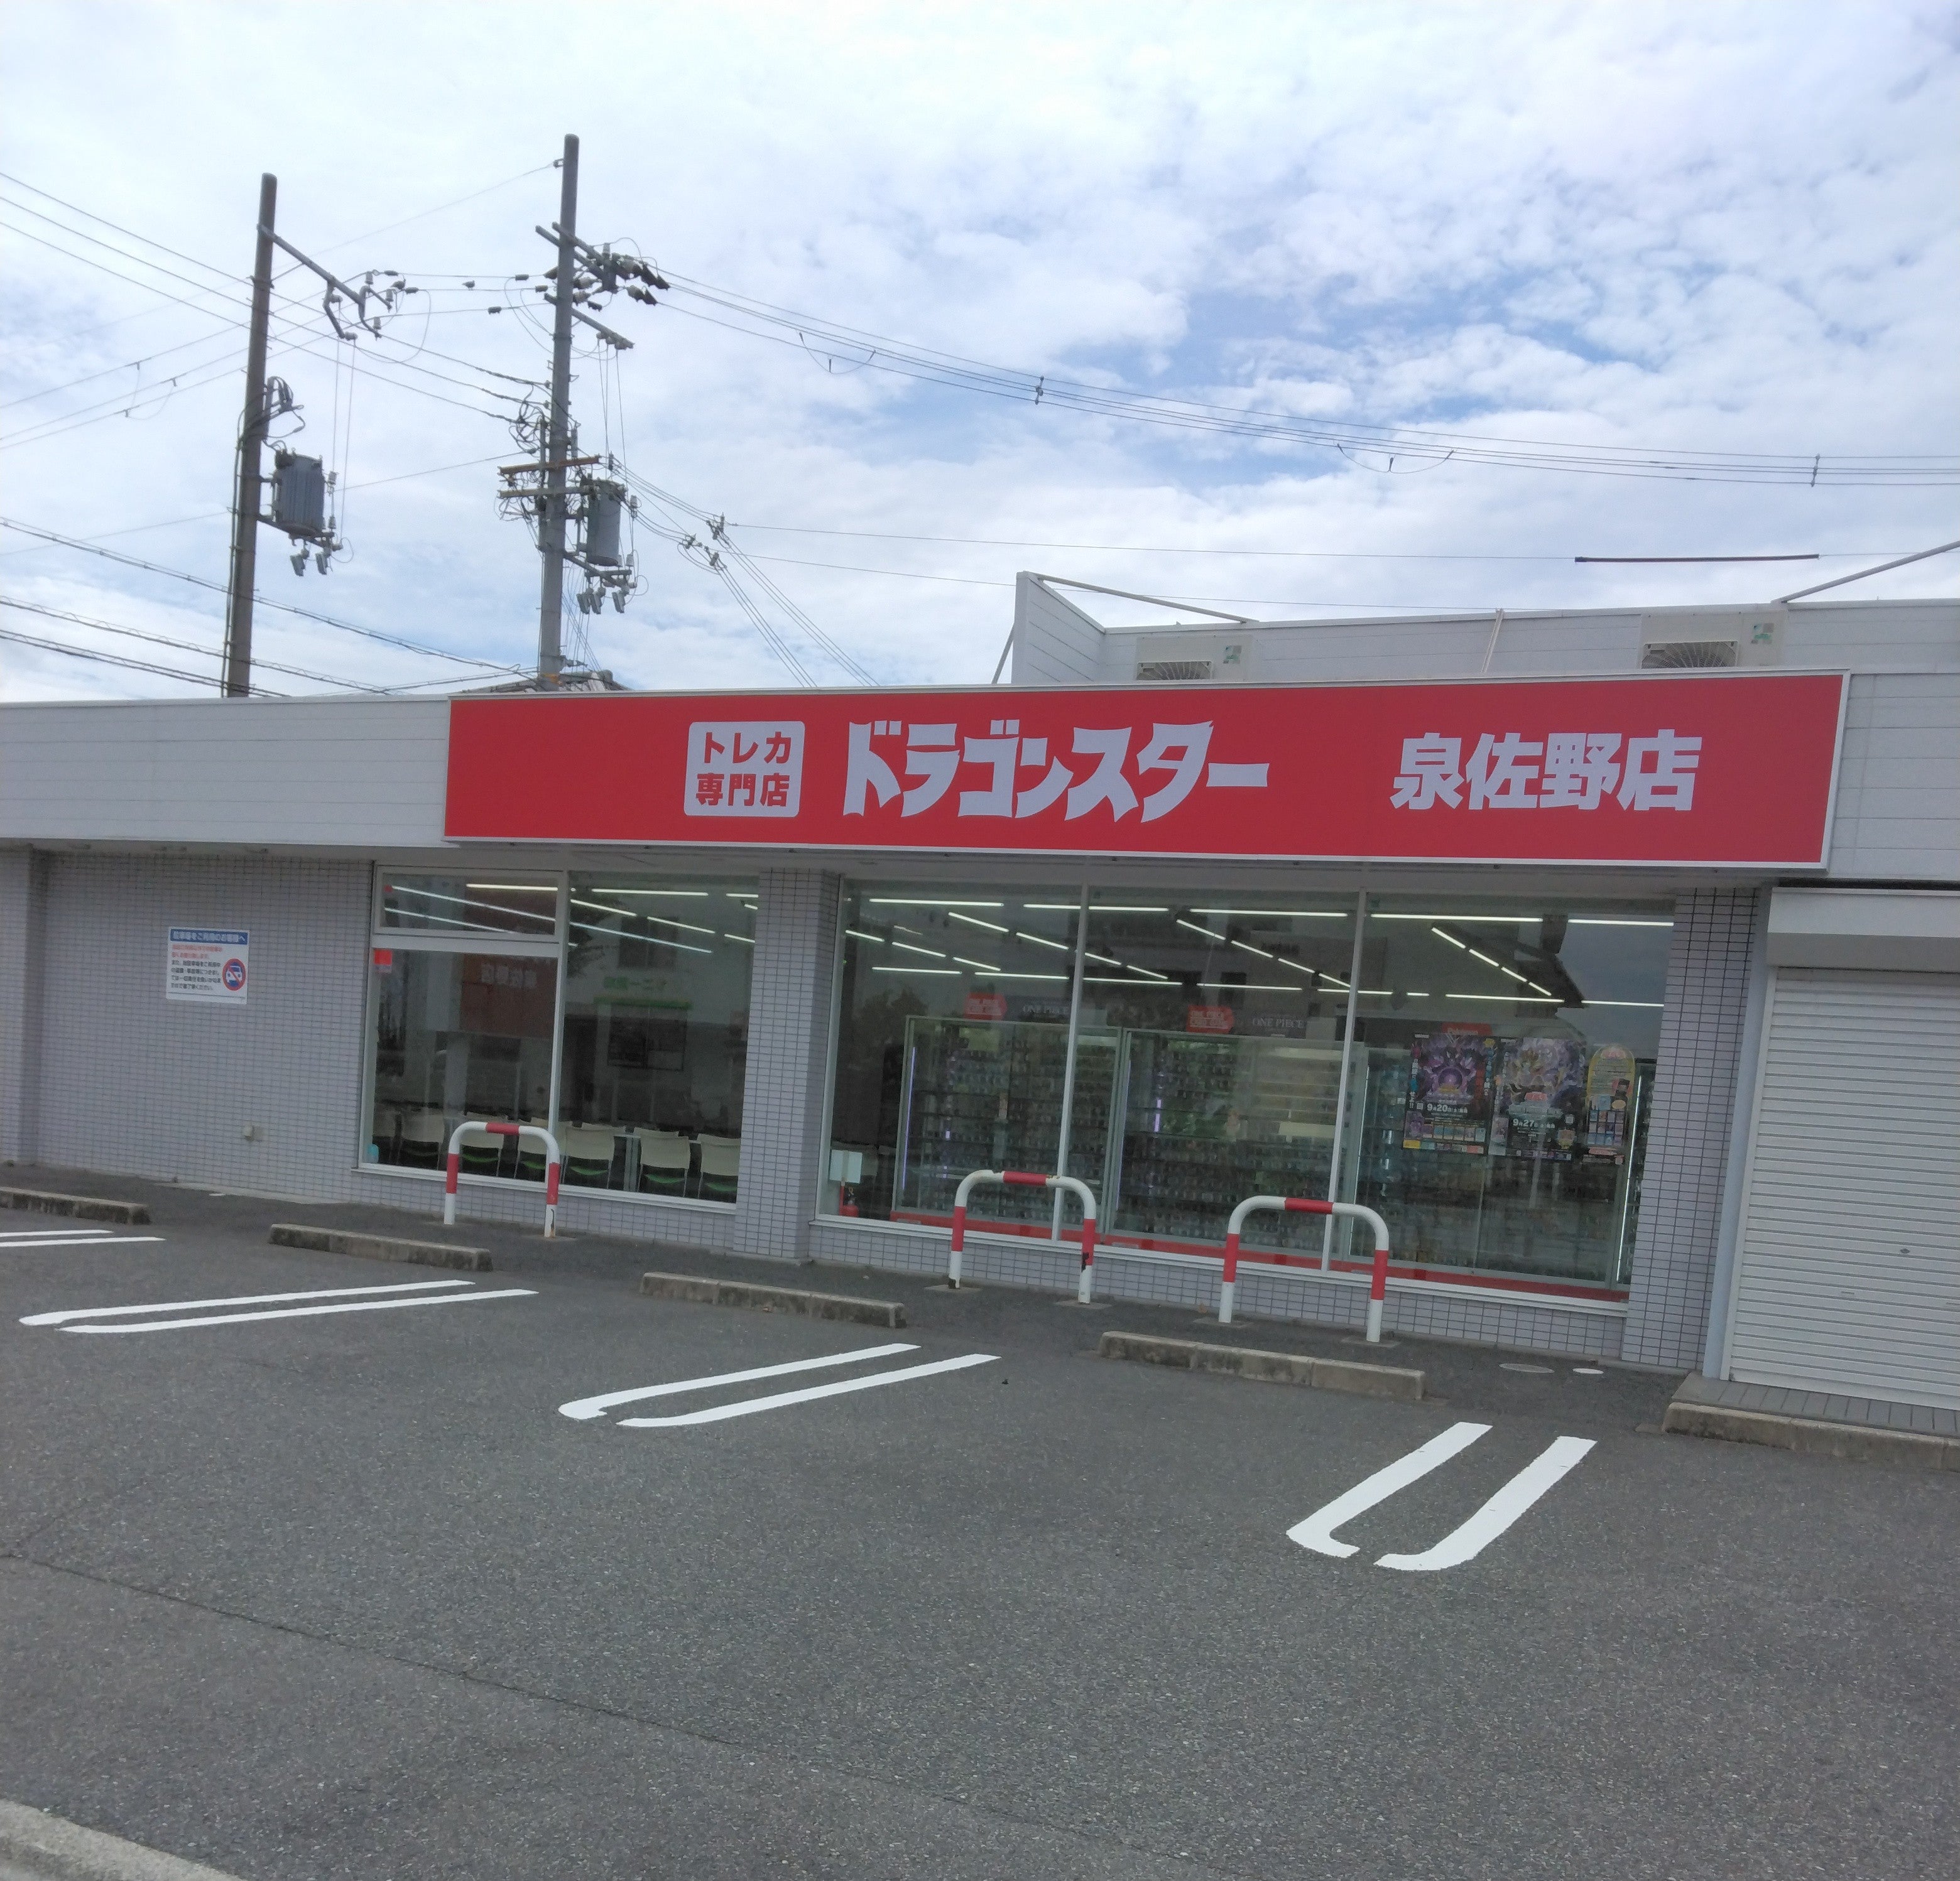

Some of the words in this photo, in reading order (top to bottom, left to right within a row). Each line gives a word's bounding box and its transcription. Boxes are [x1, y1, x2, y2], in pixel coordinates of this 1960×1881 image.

[703, 730, 792, 764] トレカ
[844, 720, 1270, 823] ドラゴンスター
[1390, 729, 1702, 811] 泉佐野店
[695, 774, 789, 808] 専門店
